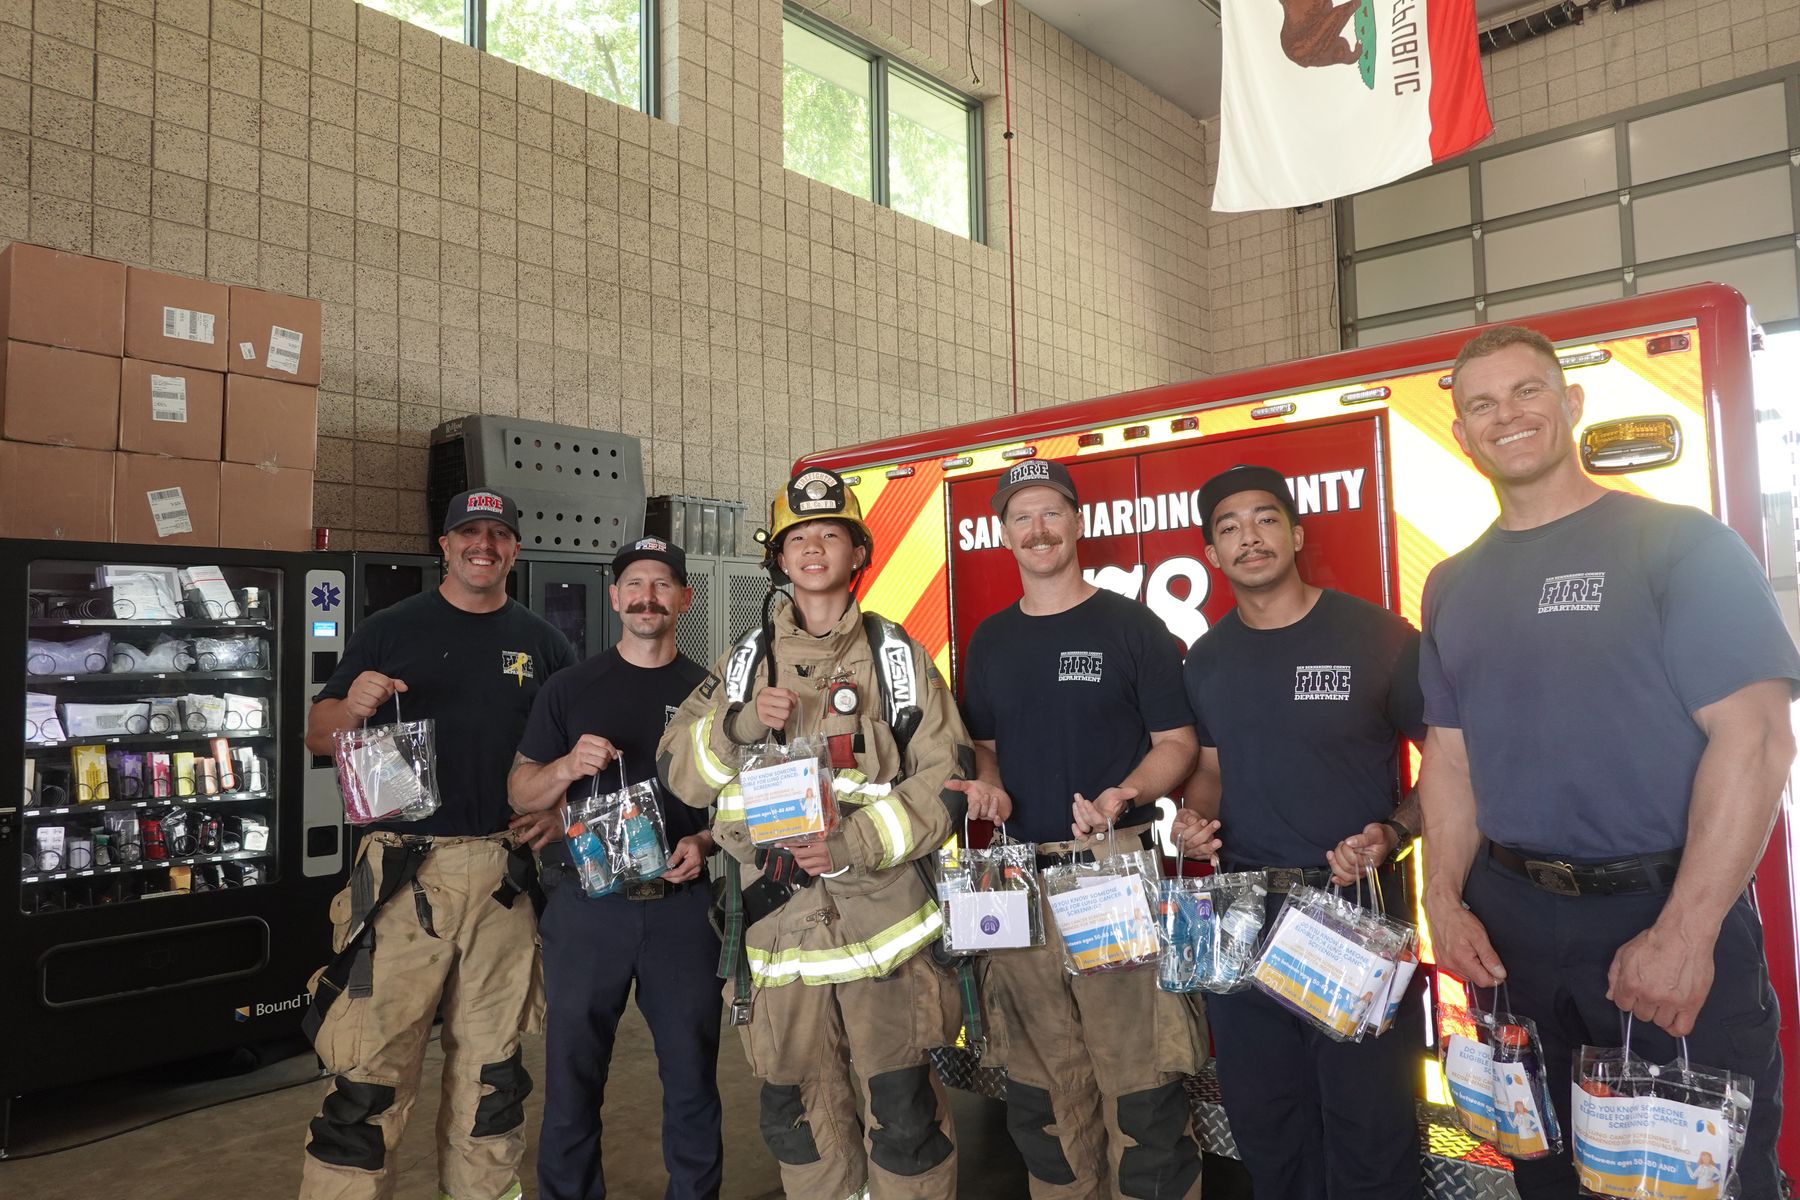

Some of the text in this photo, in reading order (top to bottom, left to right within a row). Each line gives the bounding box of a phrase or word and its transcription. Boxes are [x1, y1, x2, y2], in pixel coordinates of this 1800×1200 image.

[1011, 464, 1049, 482] FIRE
[467, 495, 503, 510] FIRE
[1539, 578, 1604, 605] FIRE
[1538, 605, 1600, 613] DEPARTMENT
[888, 648, 910, 700] MSA
[1059, 656, 1102, 675] FIRE
[1295, 670, 1351, 692] FIRE
[257, 995, 301, 1016] Bound
[1464, 1046, 1475, 1054] DO
[1580, 1104, 1613, 1121] ELIGIBLE
[1653, 1113, 1687, 1127] CANCER
[1616, 1104, 1638, 1113] KNOW
